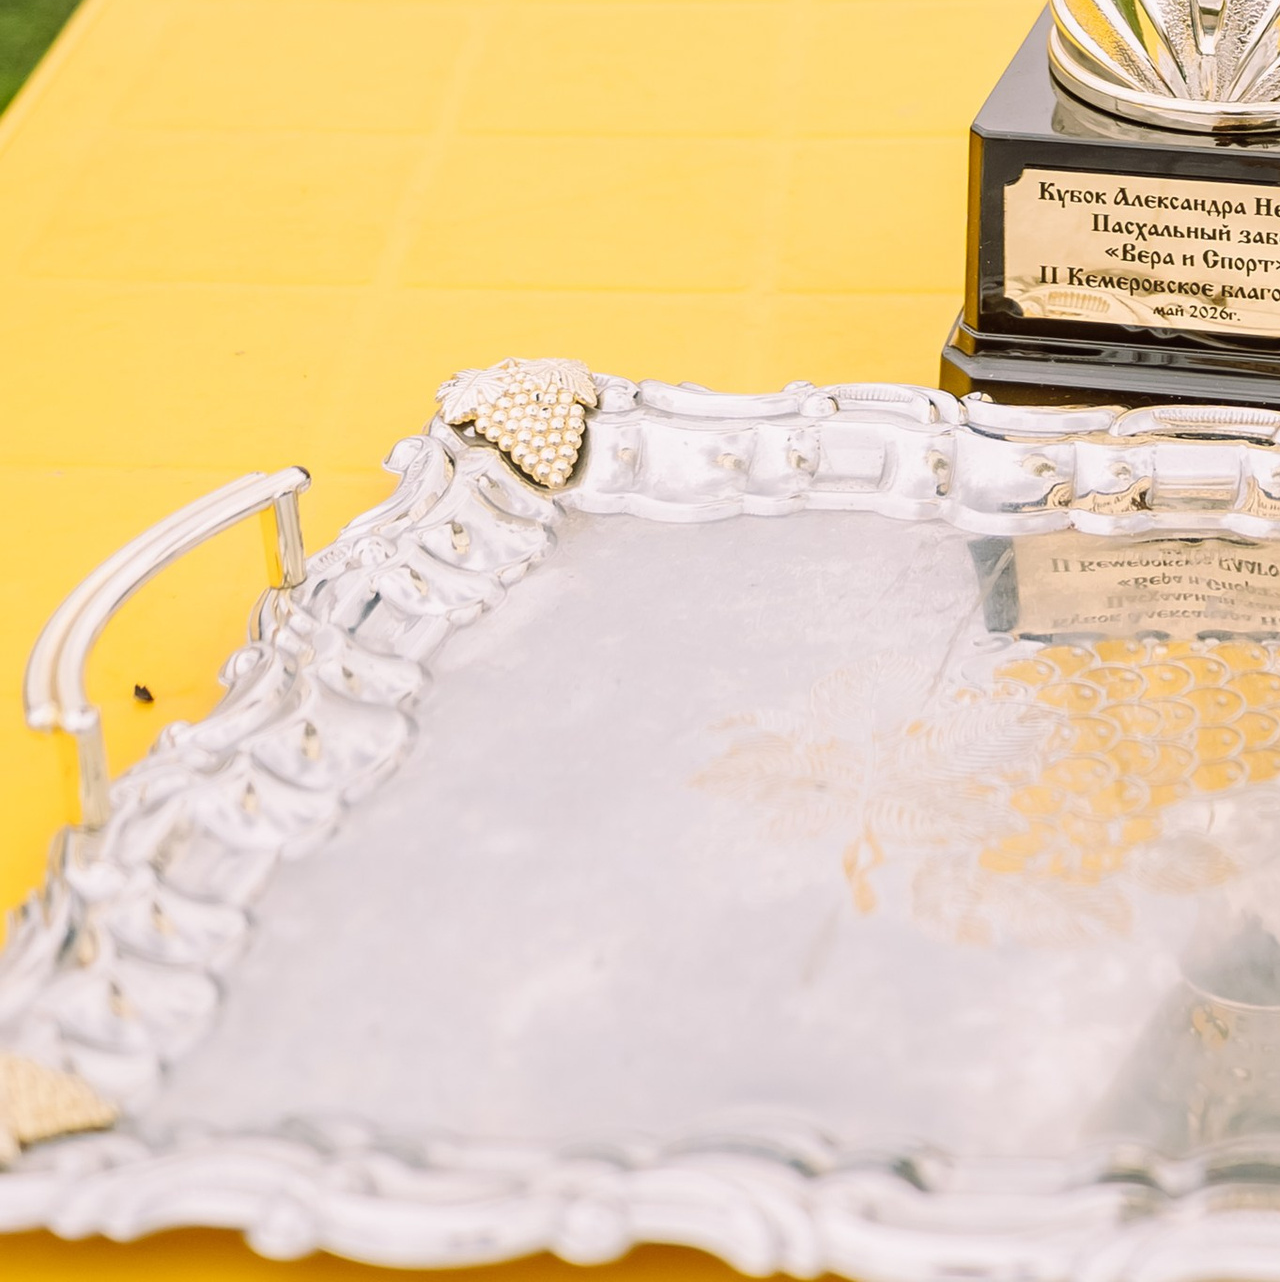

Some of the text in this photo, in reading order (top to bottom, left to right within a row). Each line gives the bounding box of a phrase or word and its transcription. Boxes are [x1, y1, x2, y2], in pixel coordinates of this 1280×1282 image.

[1038, 181, 1107, 208] Кубок
[1113, 187, 1247, 219] Александра
[1091, 213, 1231, 242] Пасхальный
[1105, 243, 1175, 269] «Вера
[1181, 253, 1195, 267] и
[1067, 267, 1214, 297] Кемеровское
[1152, 304, 1241, 322] май 2026г.
